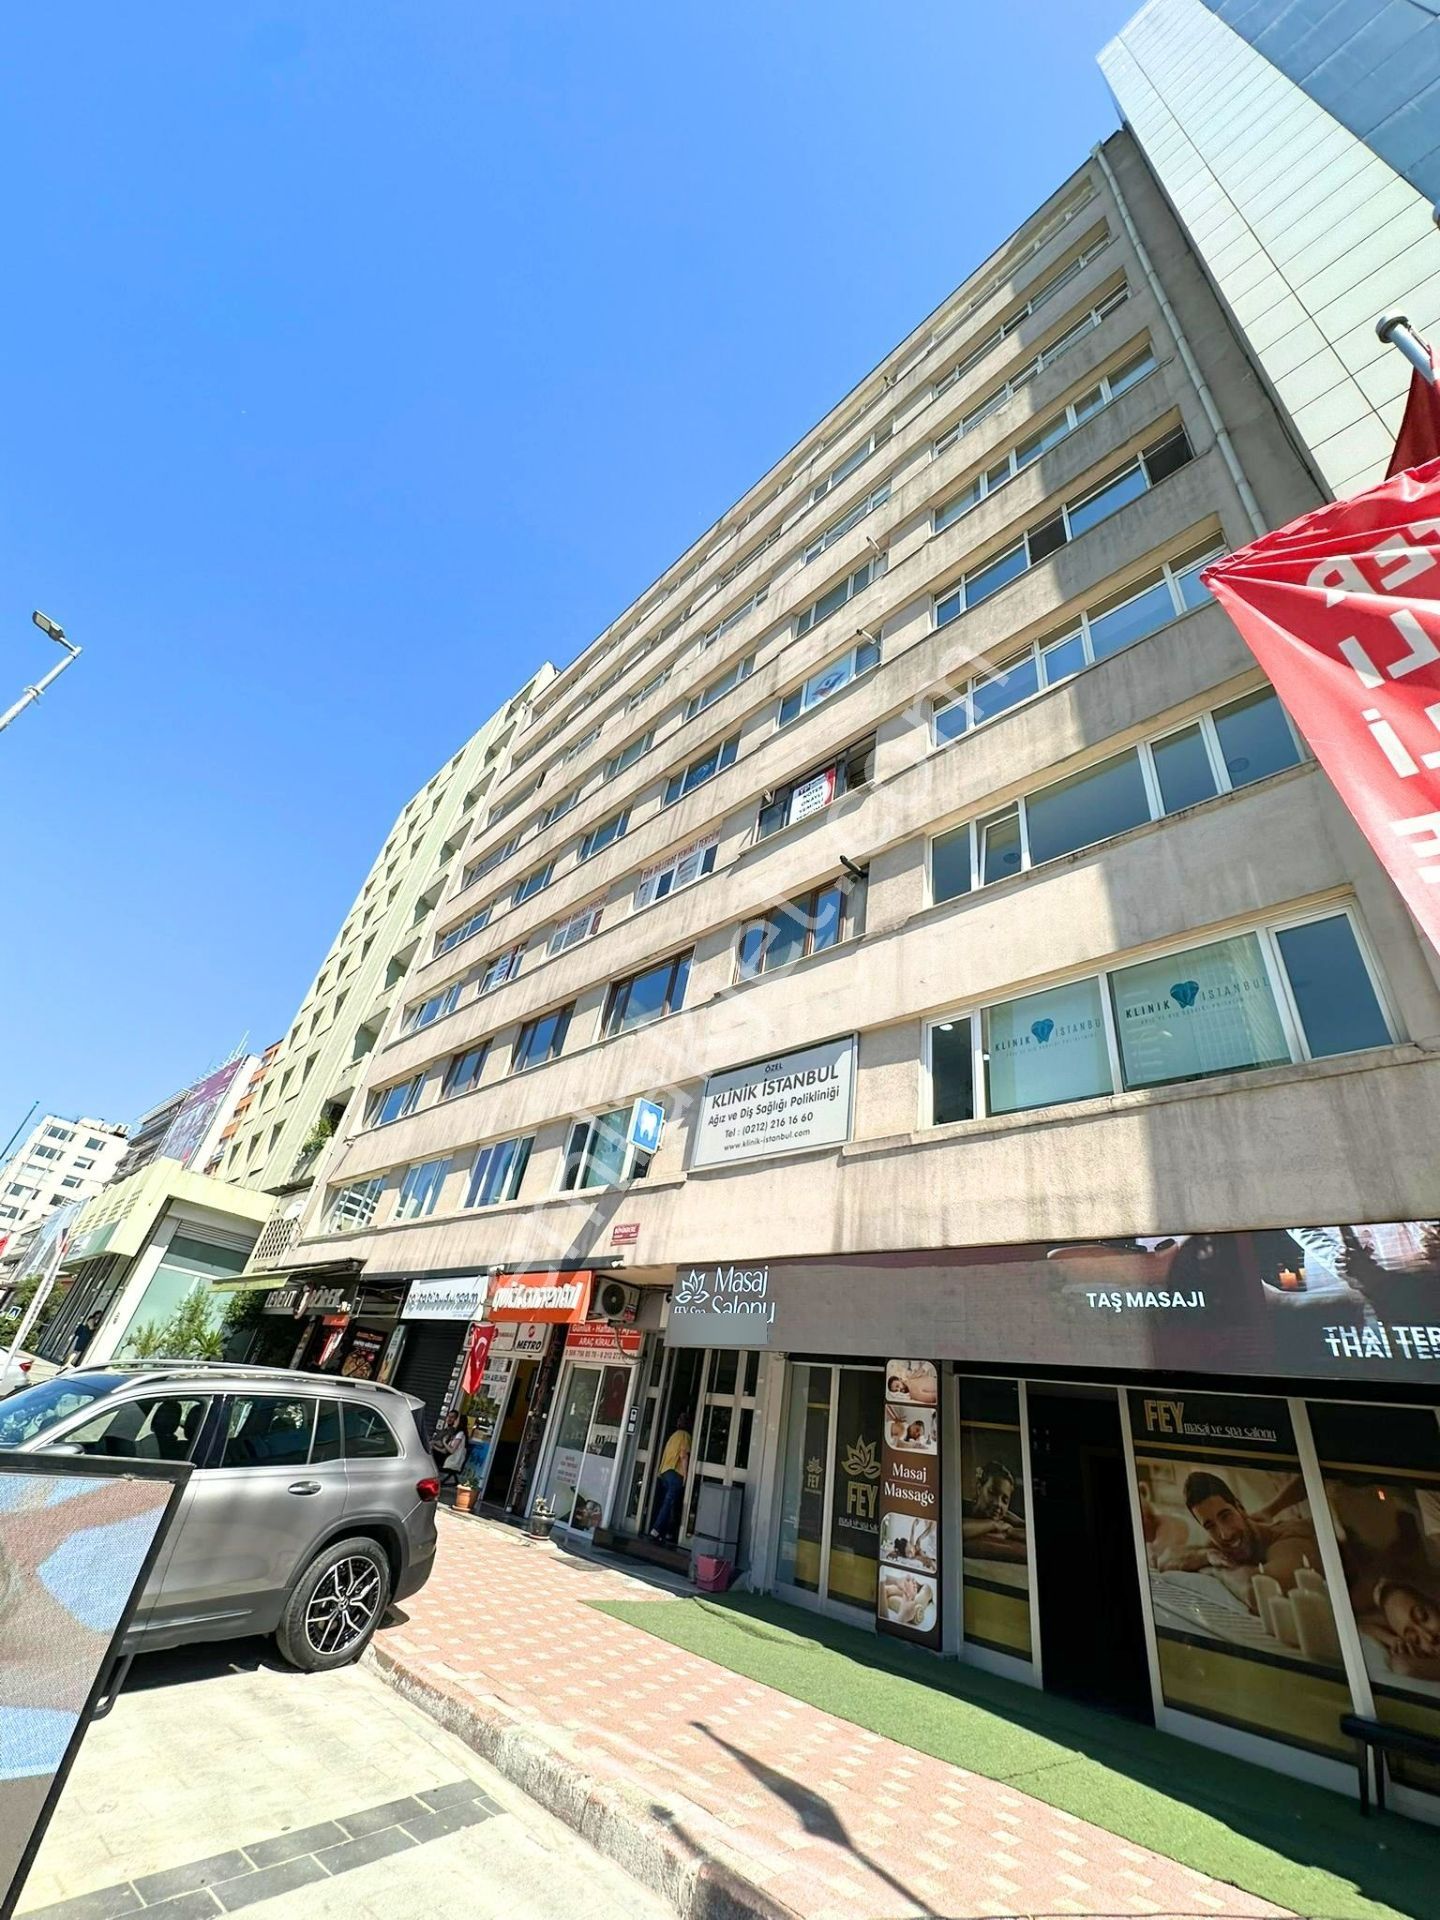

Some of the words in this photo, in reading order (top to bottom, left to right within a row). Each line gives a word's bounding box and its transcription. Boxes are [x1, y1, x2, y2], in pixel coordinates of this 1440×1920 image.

[765, 1062, 783, 1074] ÖZEL
[712, 1083, 757, 1109] KLİNİK
[762, 1064, 839, 1097] İSTANBUL
[708, 1113, 726, 1127] Ağız
[728, 1112, 738, 1121] ve
[740, 1108, 753, 1120] Diş
[756, 1100, 788, 1116] Sağlığı
[790, 1085, 840, 1107] Polikliniği
[725, 1129, 736, 1138] Tel
[742, 1123, 768, 1137] (0212)
[770, 1118, 786, 1129] 216
[788, 1116, 798, 1125] 16
[801, 1111, 814, 1122] 60
[714, 1265, 768, 1298] Masaj
[1086, 1292, 1122, 1313] TAŞ
[1126, 1291, 1206, 1308] MASAJI
[516, 1340, 542, 1350] METRO
[1143, 1399, 1185, 1433] FEY
[892, 1462, 927, 1483] Masaj
[847, 1481, 879, 1519] FEY
[884, 1482, 935, 1507] Massage
